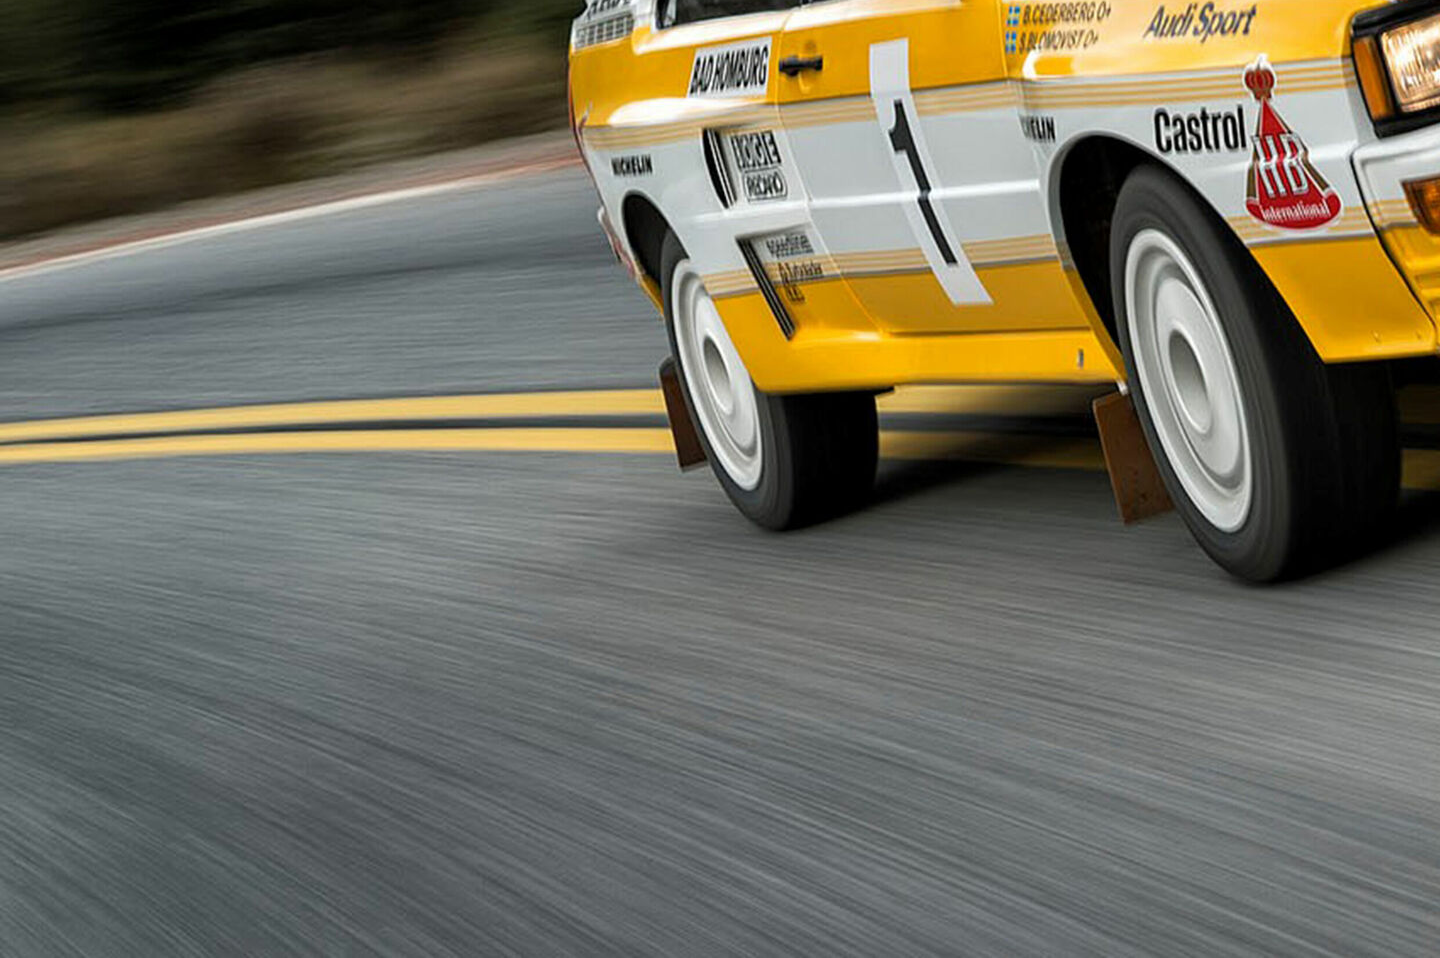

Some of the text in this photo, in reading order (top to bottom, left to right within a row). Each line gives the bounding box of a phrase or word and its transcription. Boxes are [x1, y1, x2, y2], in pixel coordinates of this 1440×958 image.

[1142, 0, 1257, 45] Audi Sport
[689, 43, 769, 95] BAD HOMBURG
[1154, 104, 1247, 154] Castrol
[888, 99, 958, 266] 1
[1251, 130, 1309, 199] HB
